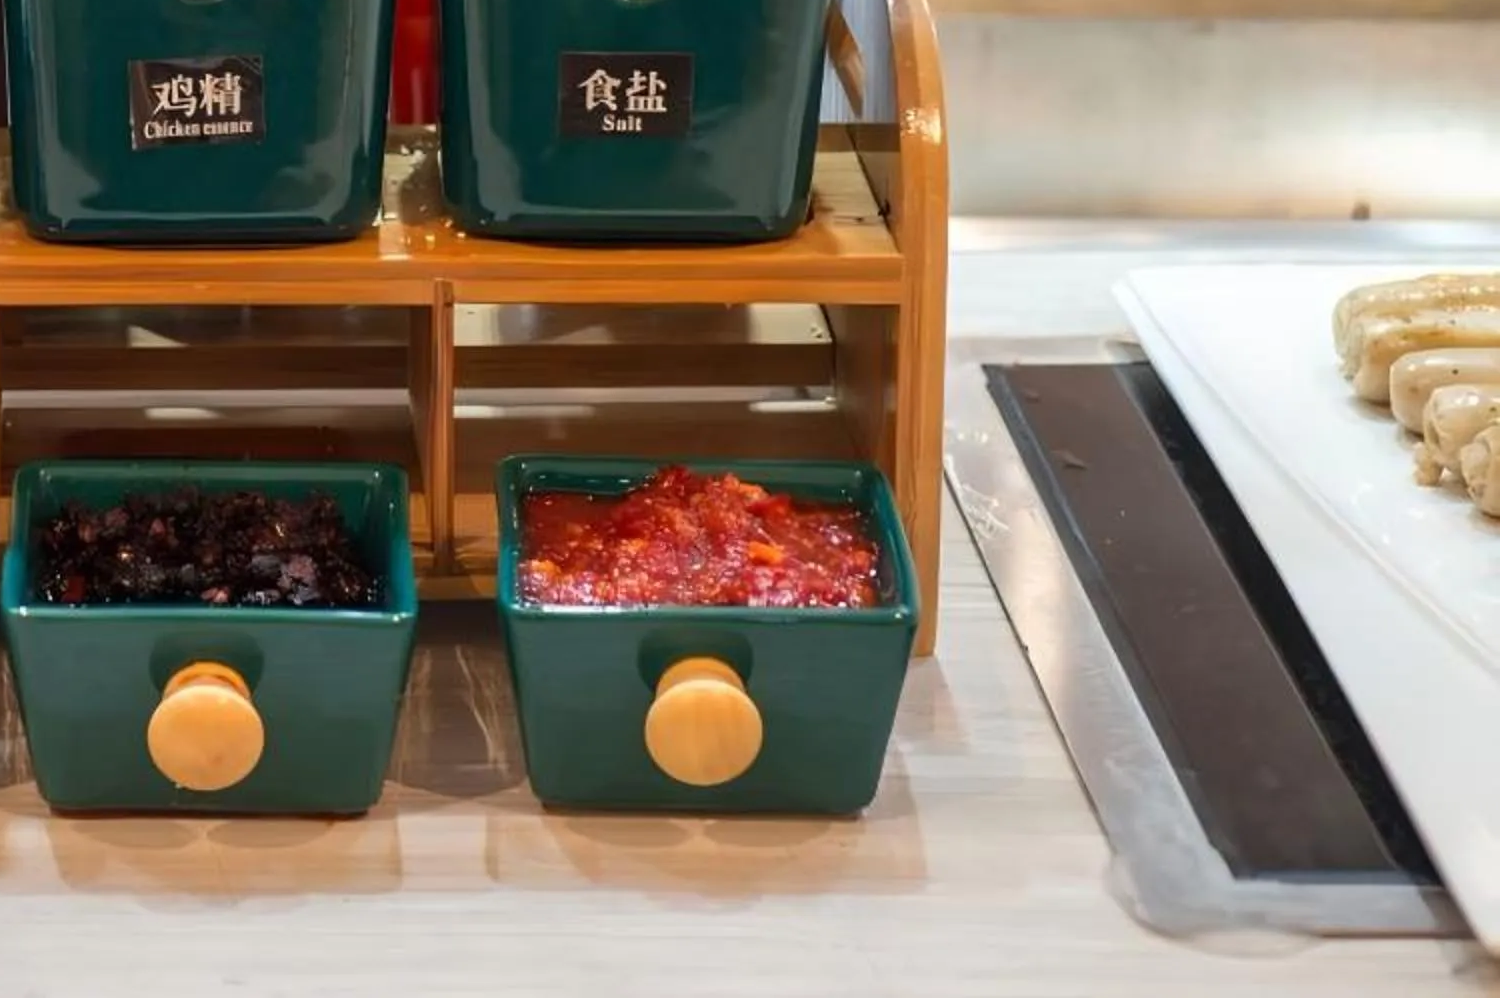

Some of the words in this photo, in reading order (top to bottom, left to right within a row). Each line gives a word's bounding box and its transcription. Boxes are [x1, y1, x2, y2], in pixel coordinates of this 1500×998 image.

[150, 72, 242, 117] 鸡精
[577, 69, 668, 113] 食盐
[144, 120, 201, 139] Chicken
[602, 113, 643, 132] Salt
